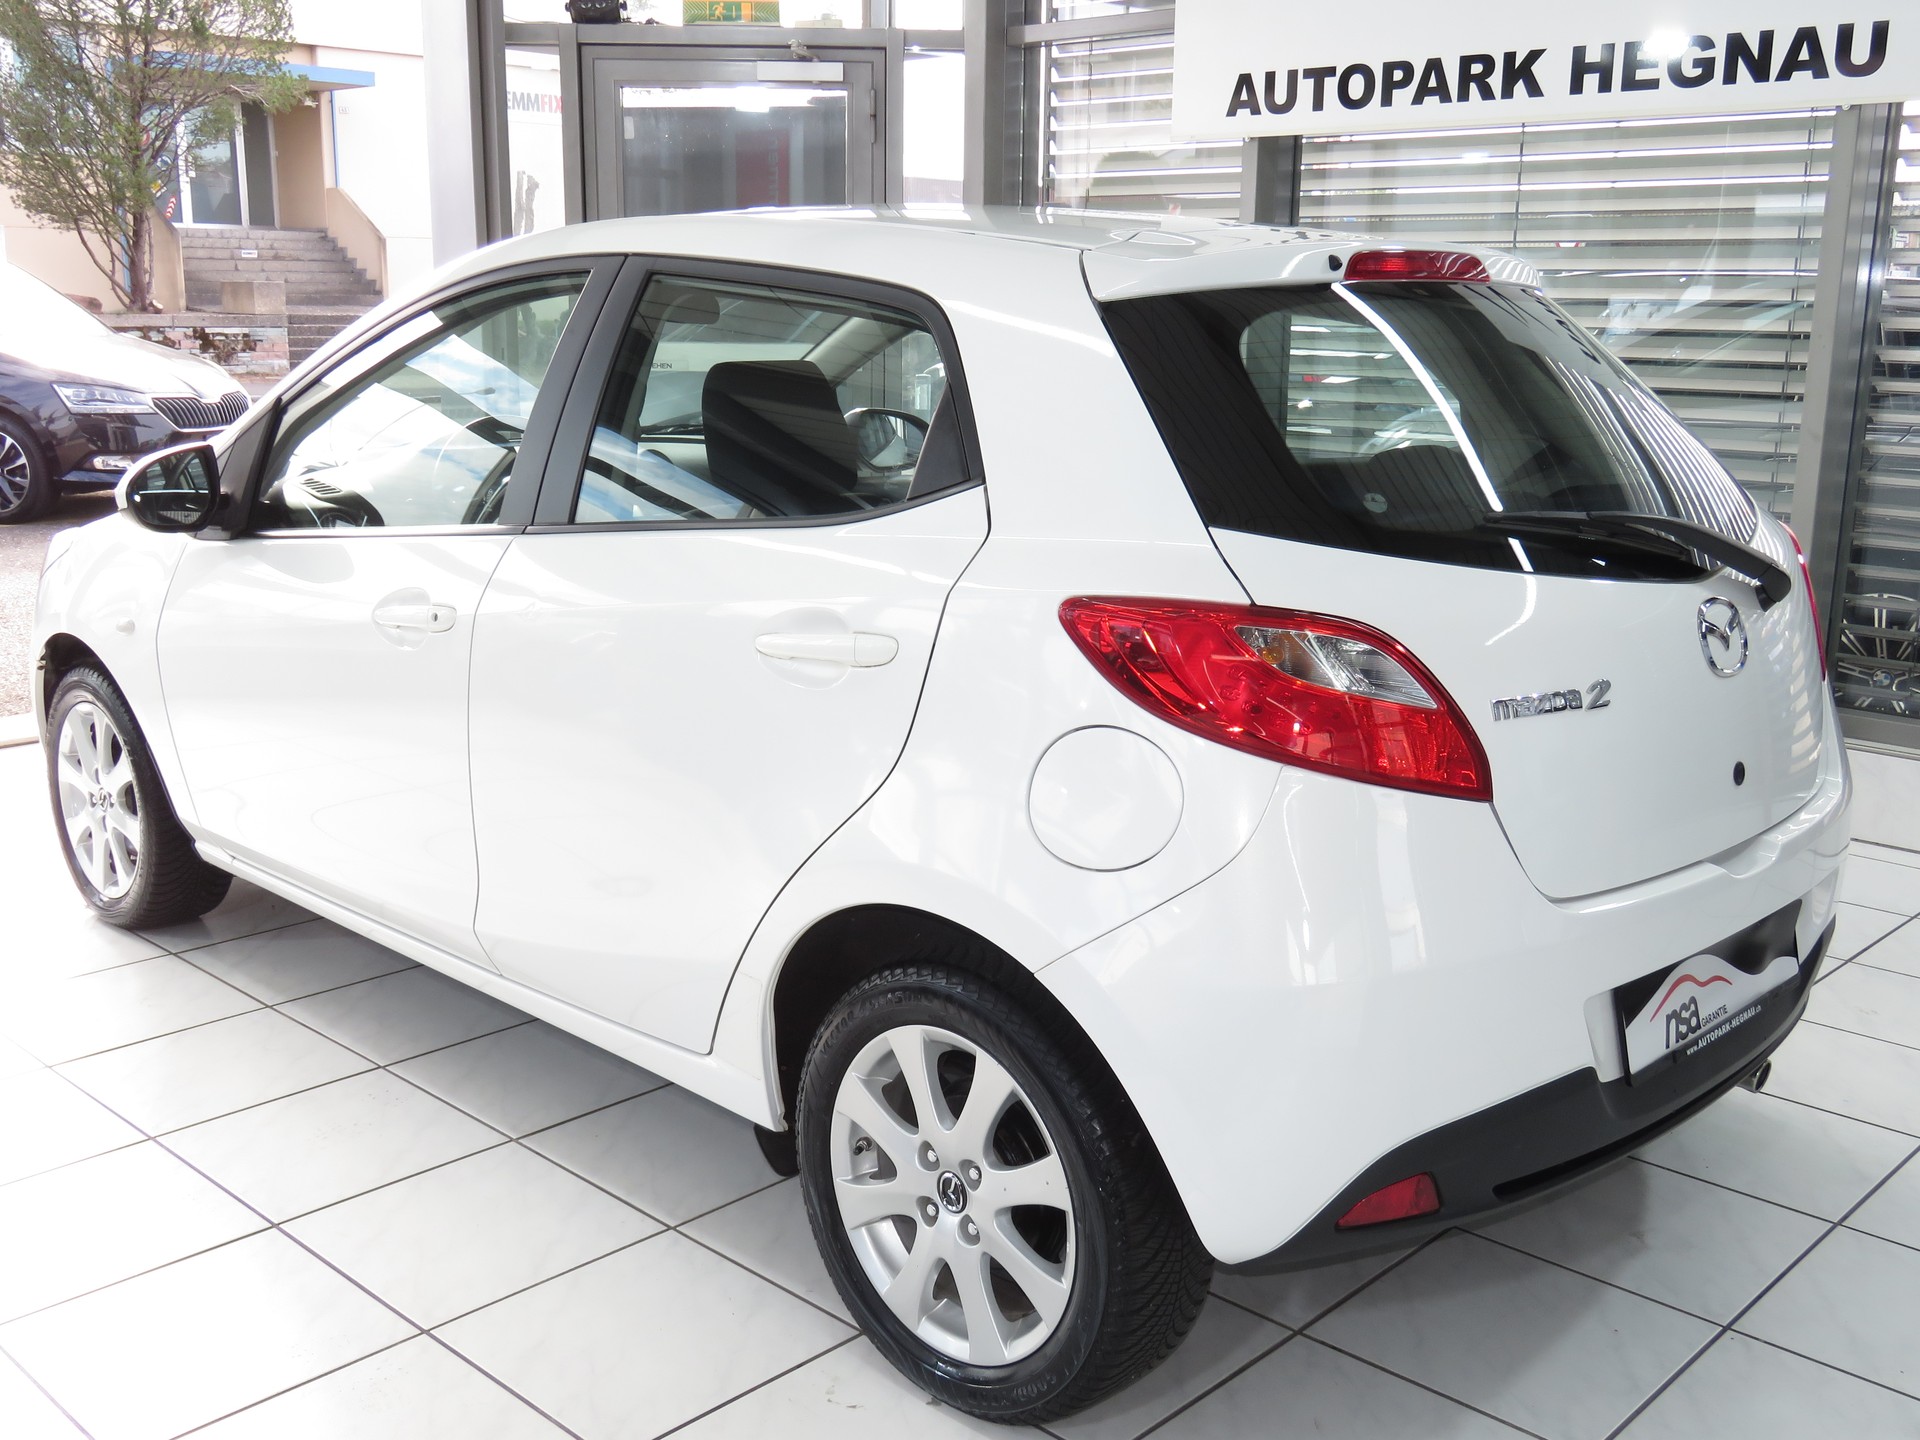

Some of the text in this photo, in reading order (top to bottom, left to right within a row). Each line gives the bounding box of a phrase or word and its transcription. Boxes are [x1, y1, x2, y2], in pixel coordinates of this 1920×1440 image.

[1226, 20, 1890, 118] AUTOPARK HEGNAU
[1665, 996, 1701, 1050] nsa
[1701, 1004, 1728, 1027] GARANTIE
